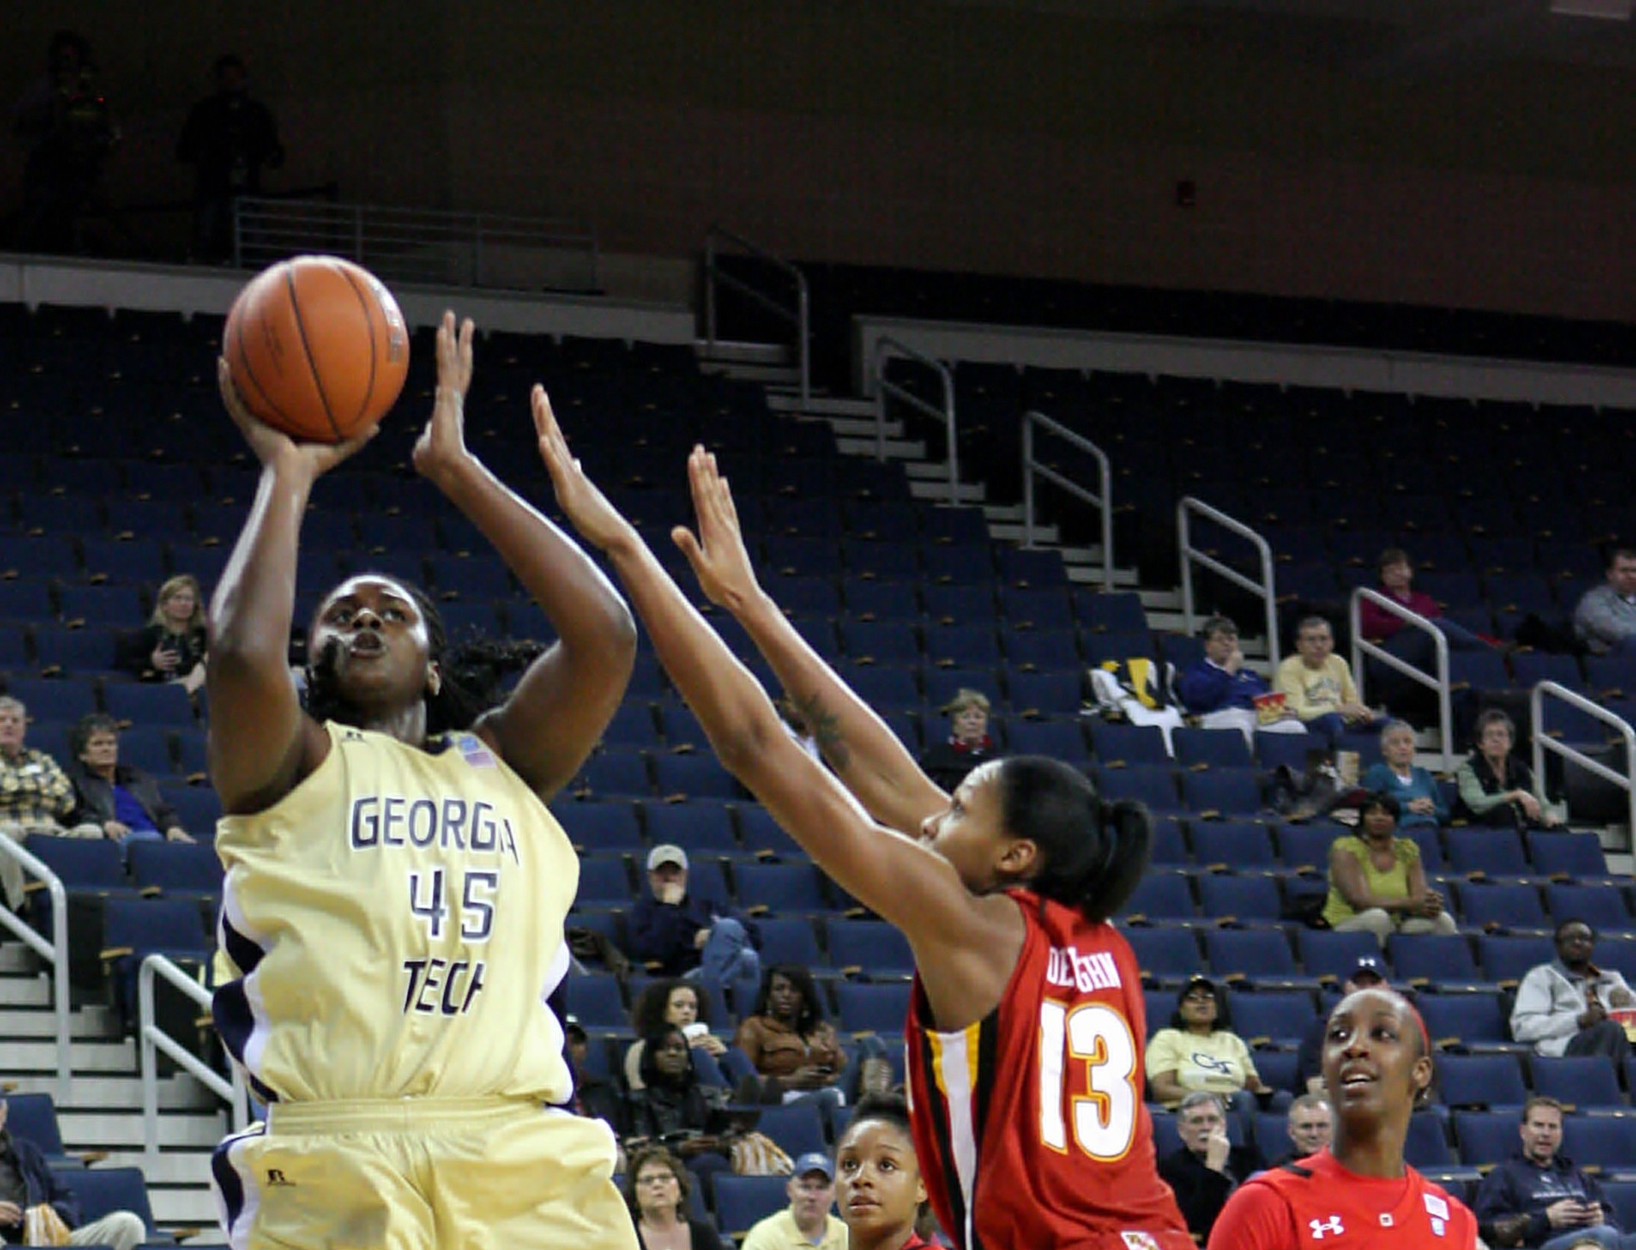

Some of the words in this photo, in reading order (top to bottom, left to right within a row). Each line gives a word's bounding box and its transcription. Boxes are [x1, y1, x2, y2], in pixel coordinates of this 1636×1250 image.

[352, 796, 519, 866] GEORGA
[409, 868, 498, 940] 45
[1039, 997, 1137, 1162] 13
